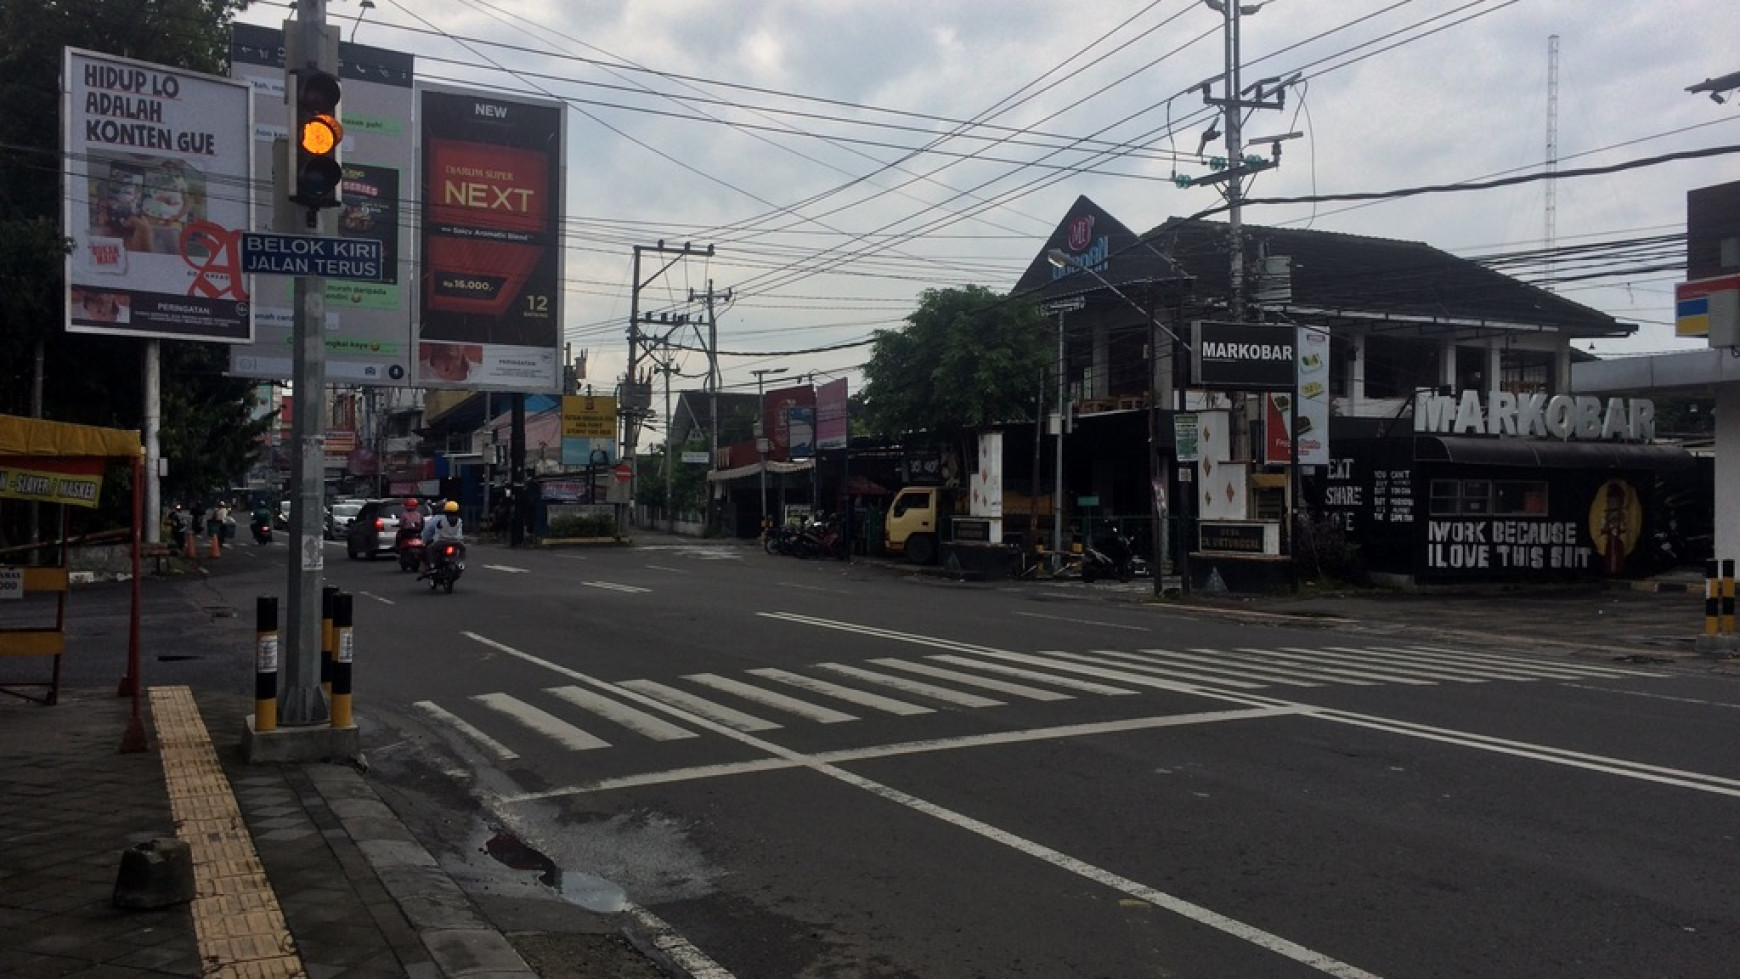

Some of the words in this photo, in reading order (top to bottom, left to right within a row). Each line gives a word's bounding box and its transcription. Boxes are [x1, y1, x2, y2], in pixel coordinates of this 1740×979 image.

[85, 64, 147, 93] HIDUP
[152, 75, 180, 98] LO
[85, 92, 162, 123] ADALAH
[475, 103, 508, 118] NEW
[86, 120, 172, 150] KONTEN
[177, 132, 215, 155] GUE
[485, 169, 514, 181] SUPER
[444, 179, 534, 213] NEXT
[474, 230, 507, 240] Aromatic
[247, 236, 324, 256] BELOK
[334, 242, 377, 259] KIRI
[248, 256, 308, 273] JALAN
[315, 259, 376, 277] TERUS
[526, 295, 548, 311] 12
[1202, 341, 1293, 361] MARKOBAR
[1413, 387, 1656, 443] MARKOBAR
[1325, 485, 1363, 506] SHARE
[1492, 521, 1577, 545] BECAUSE
[1428, 543, 1433, 568] I
[1436, 544, 1489, 569] LOVE
[1497, 545, 1544, 569] THIS
